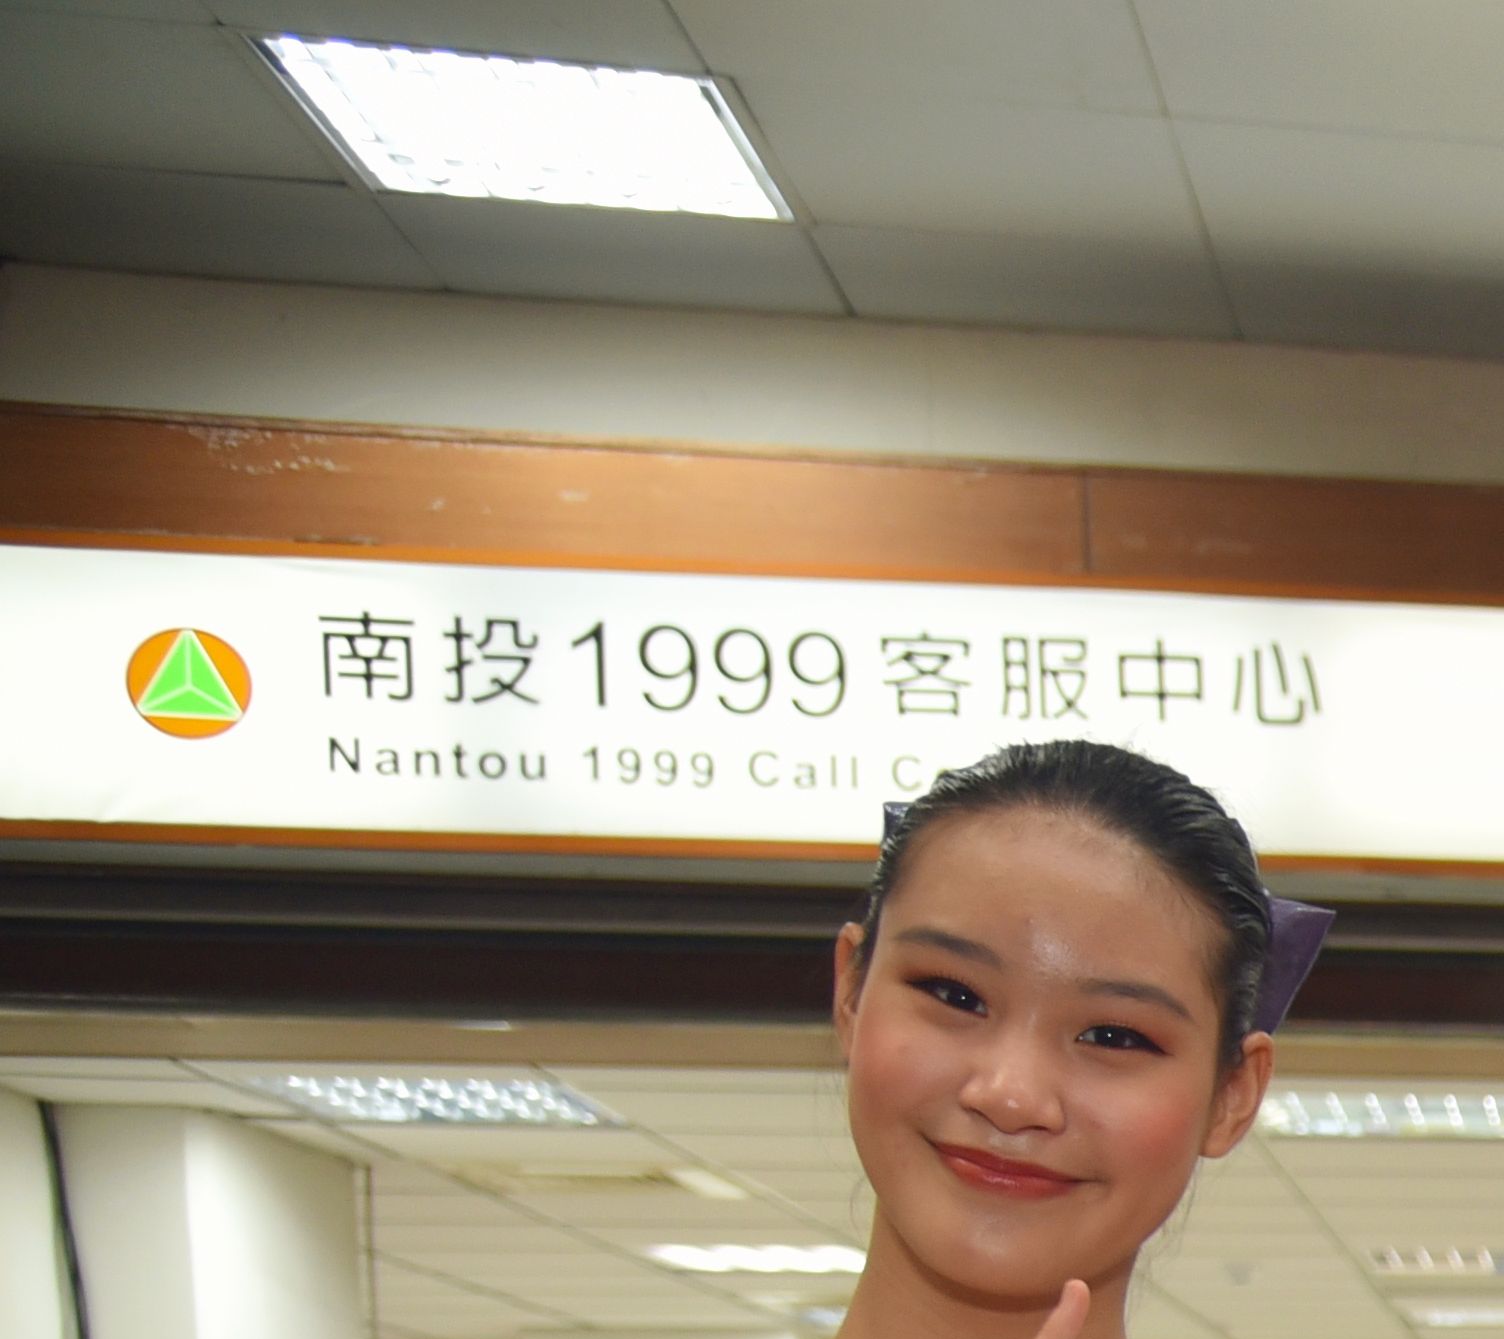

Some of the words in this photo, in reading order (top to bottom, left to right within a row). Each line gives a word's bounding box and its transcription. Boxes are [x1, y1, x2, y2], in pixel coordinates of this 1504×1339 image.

[328, 738, 549, 785] Nantou
[582, 744, 717, 791] 1999
[746, 748, 860, 794] Call
